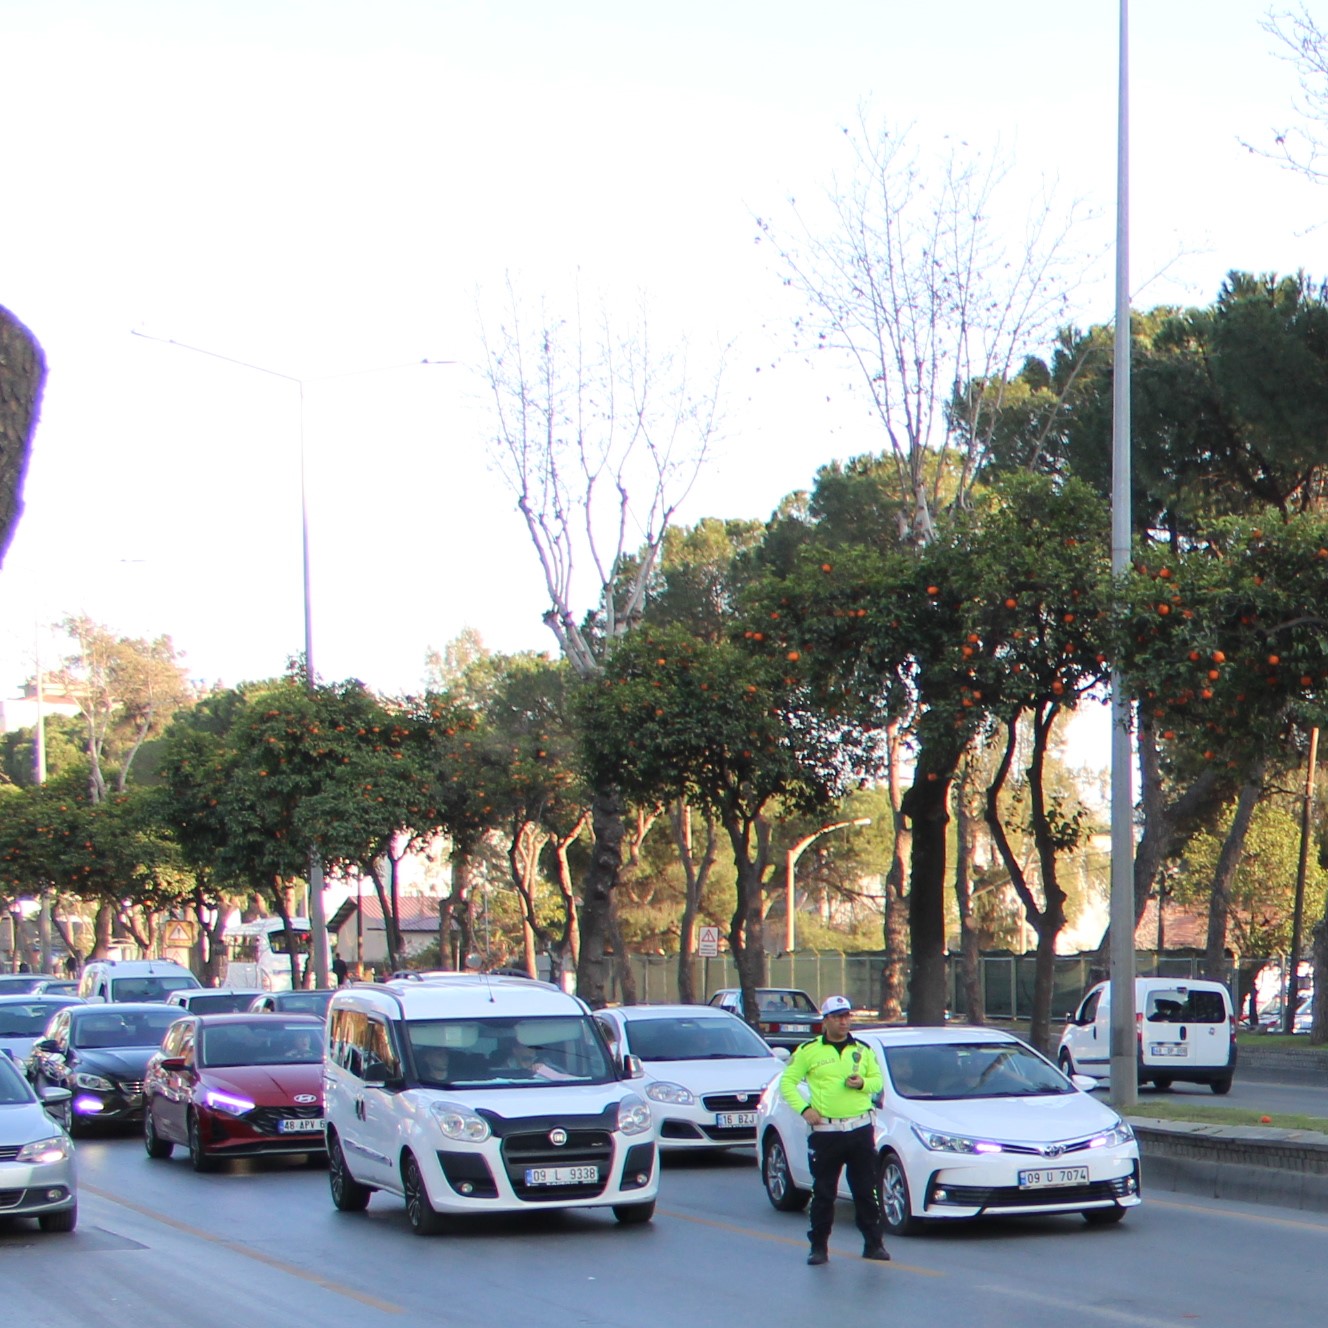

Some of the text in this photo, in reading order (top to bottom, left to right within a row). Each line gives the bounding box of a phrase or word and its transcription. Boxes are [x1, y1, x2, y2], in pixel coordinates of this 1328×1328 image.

[284, 1120, 295, 1130] 48
[533, 1169, 547, 1182] 09
[570, 1167, 596, 1180] 9338
[1027, 1172, 1040, 1184] 09
[1060, 1169, 1086, 1181] 7074
